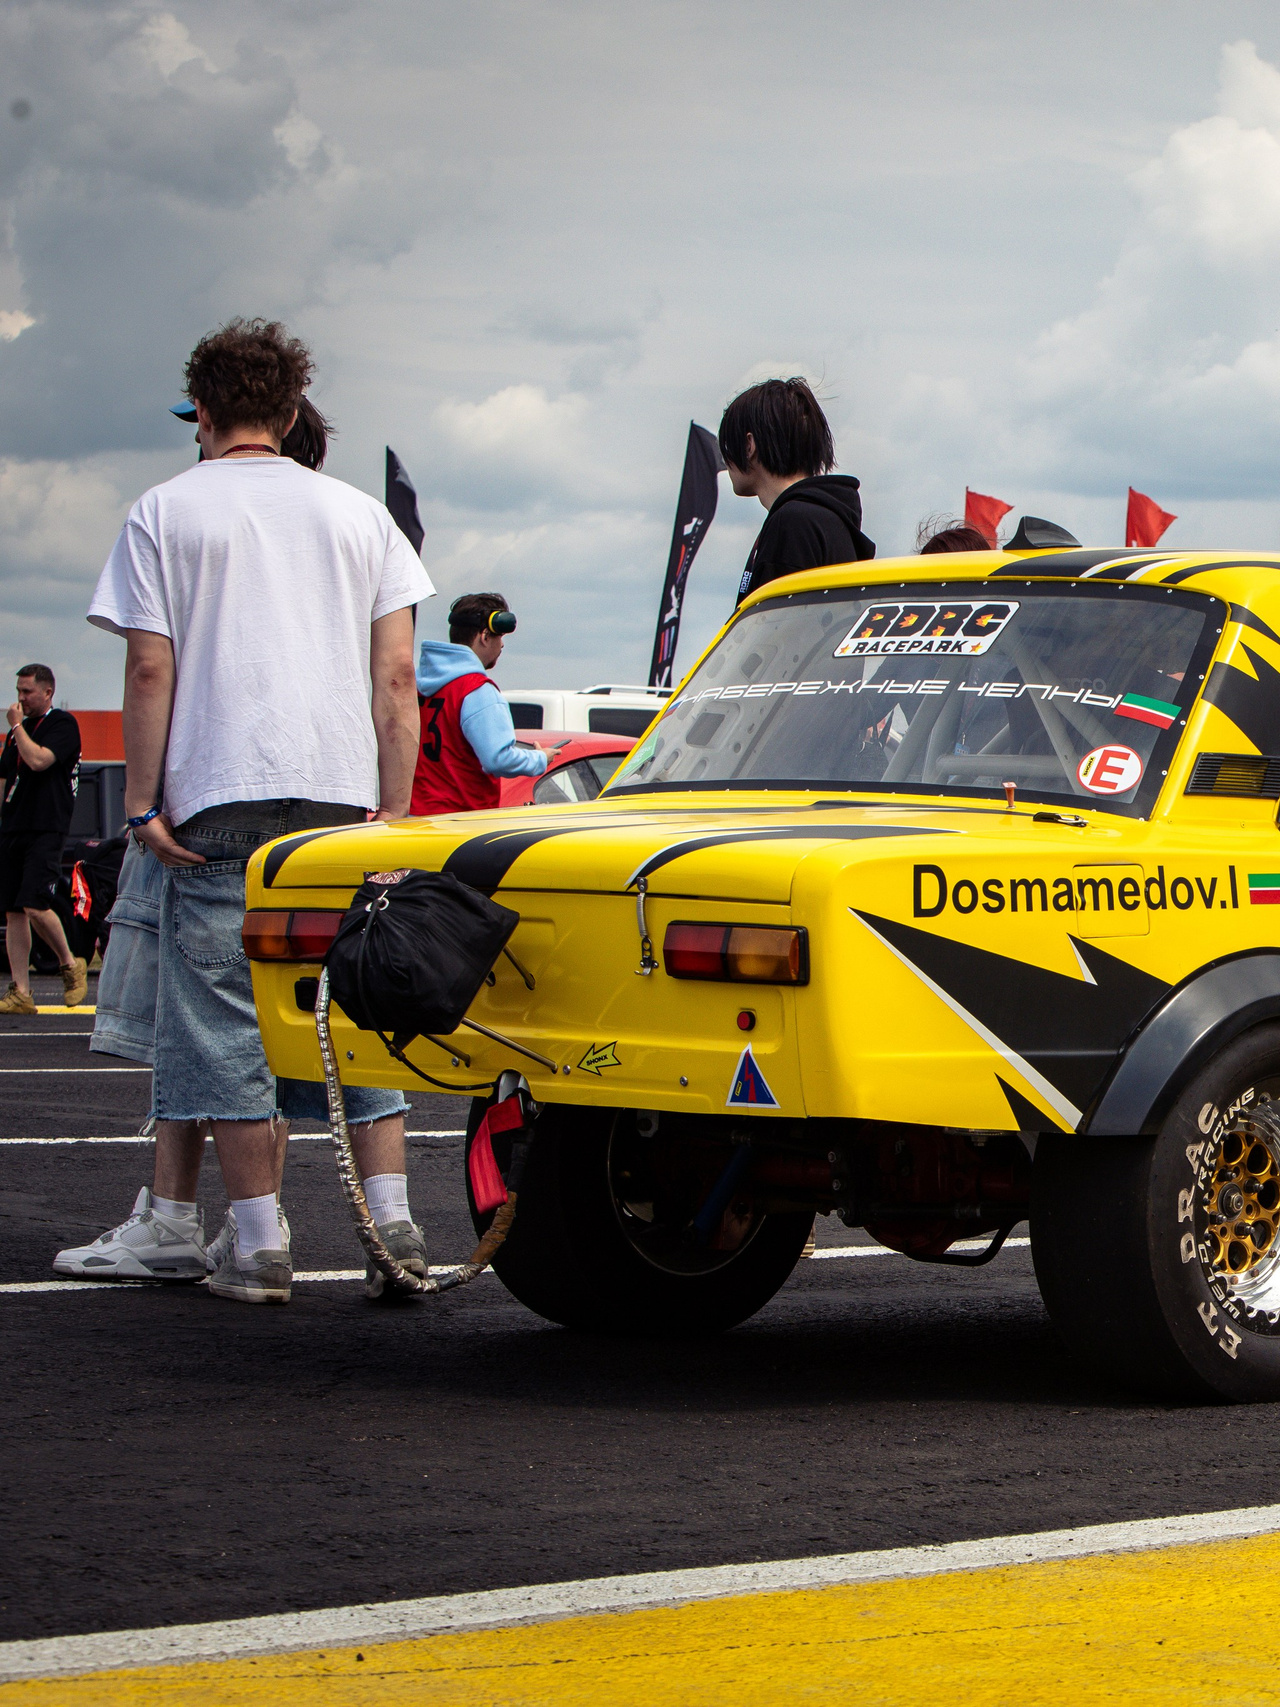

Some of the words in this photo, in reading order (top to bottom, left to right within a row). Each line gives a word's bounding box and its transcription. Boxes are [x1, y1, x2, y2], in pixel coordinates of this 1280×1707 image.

[850, 604, 1011, 639] RDRC
[851, 640, 970, 654] RACEPARK
[677, 680, 950, 709] НАБЕРЕЖНЫЕ
[957, 681, 1124, 709] ЧЕЛНЫ
[1089, 749, 1131, 791] E
[586, 1053, 609, 1067] SHONX
